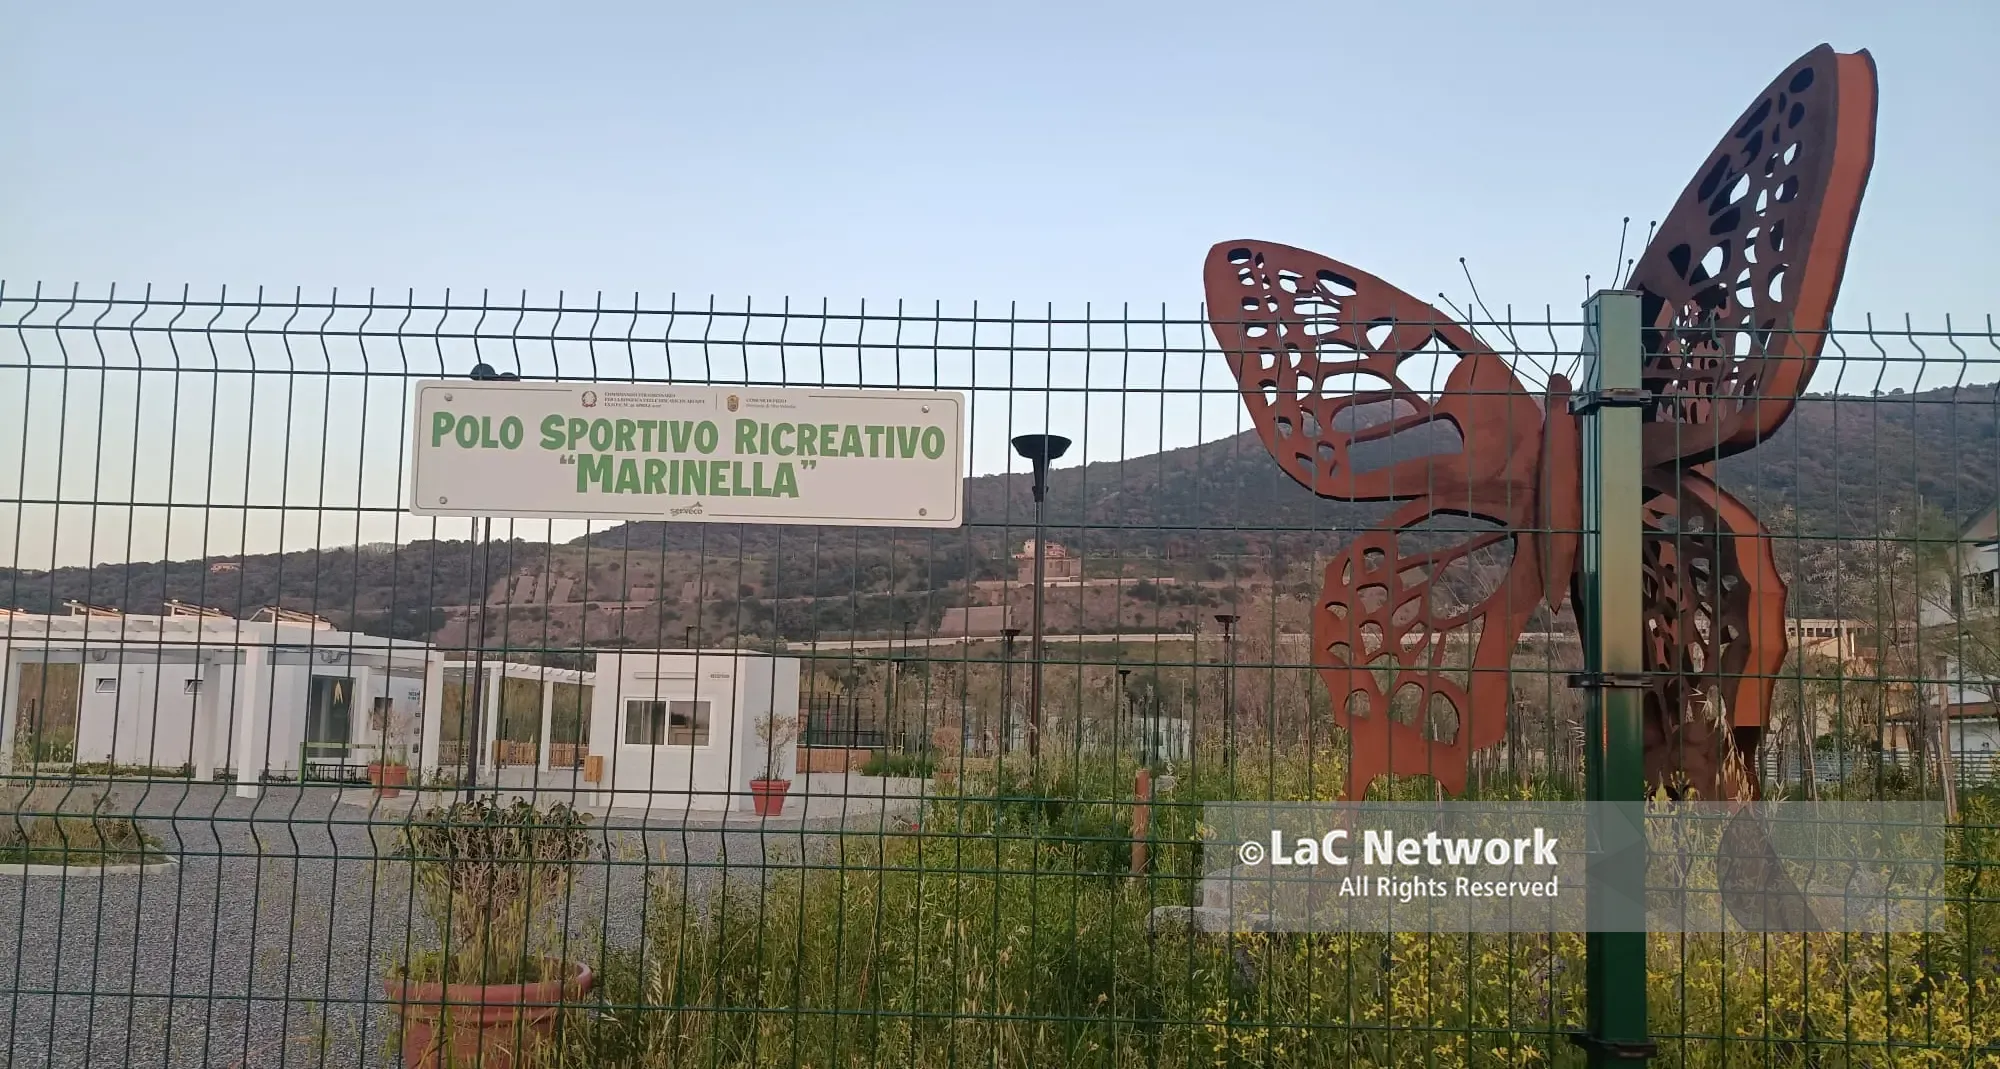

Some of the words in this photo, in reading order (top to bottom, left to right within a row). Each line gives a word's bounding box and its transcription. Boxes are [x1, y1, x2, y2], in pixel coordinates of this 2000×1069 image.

[431, 411, 523, 450] POLO
[539, 413, 719, 454] SPORTIVO
[734, 419, 946, 459] RICREATIVO
